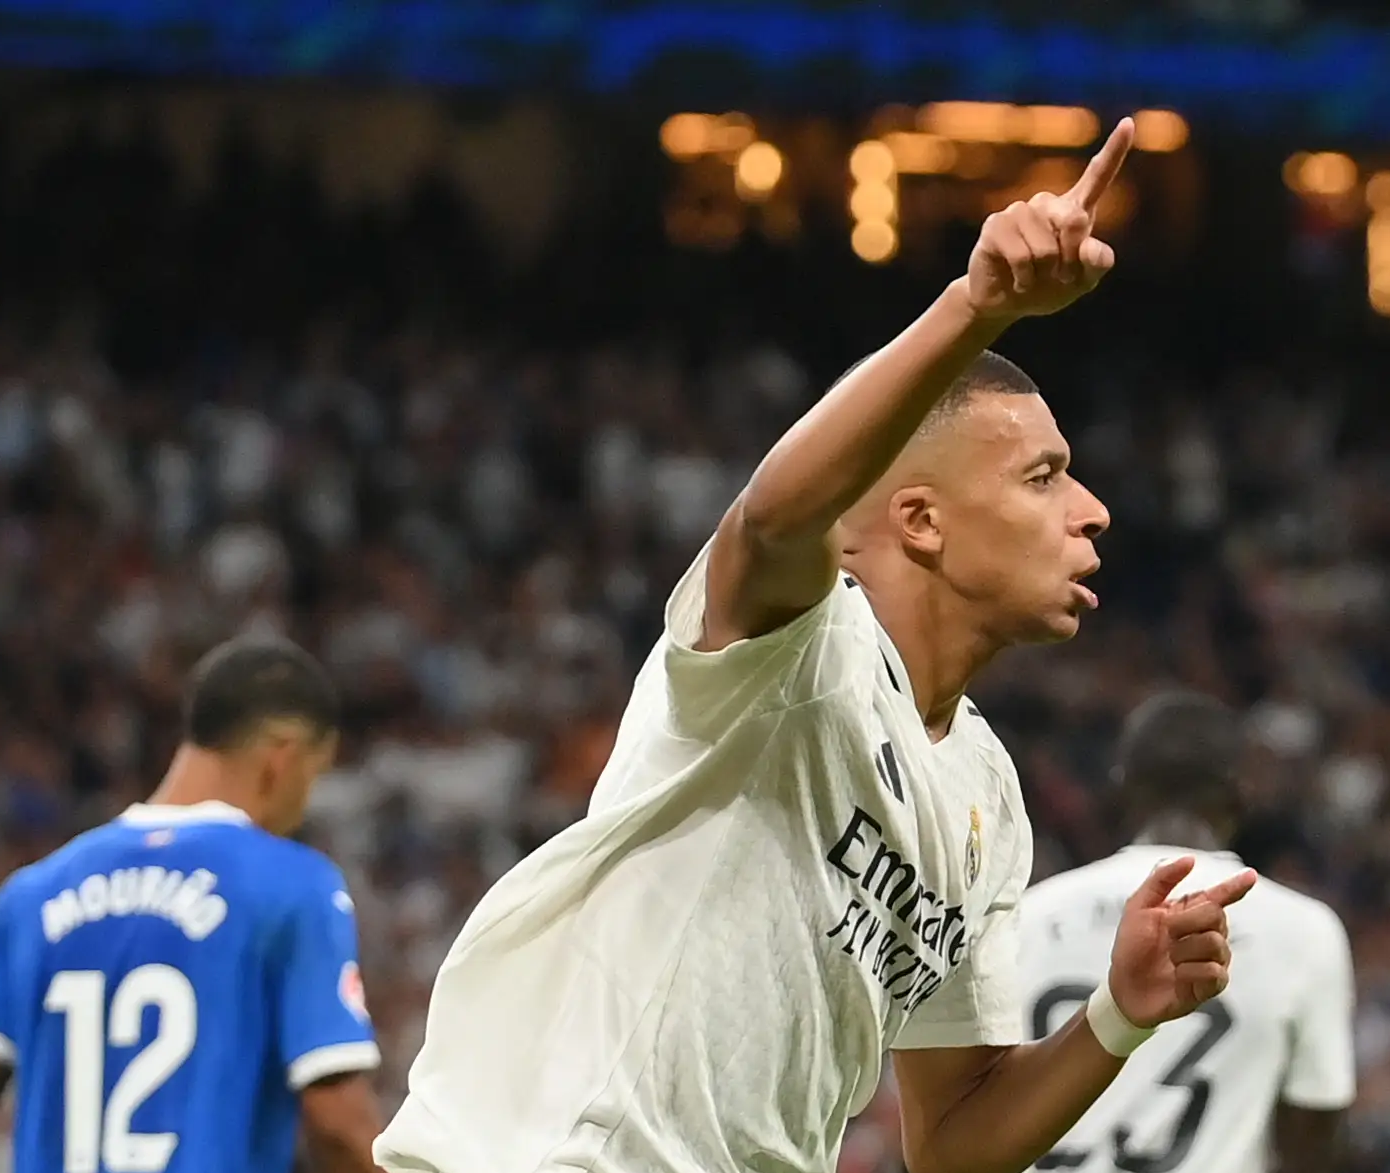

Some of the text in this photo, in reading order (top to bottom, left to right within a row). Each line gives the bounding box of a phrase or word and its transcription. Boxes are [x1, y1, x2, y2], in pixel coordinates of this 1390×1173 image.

[41, 866, 229, 944] MOURIÑO
[826, 804, 967, 971] Emirate
[826, 898, 942, 1015] FLY BETTER
